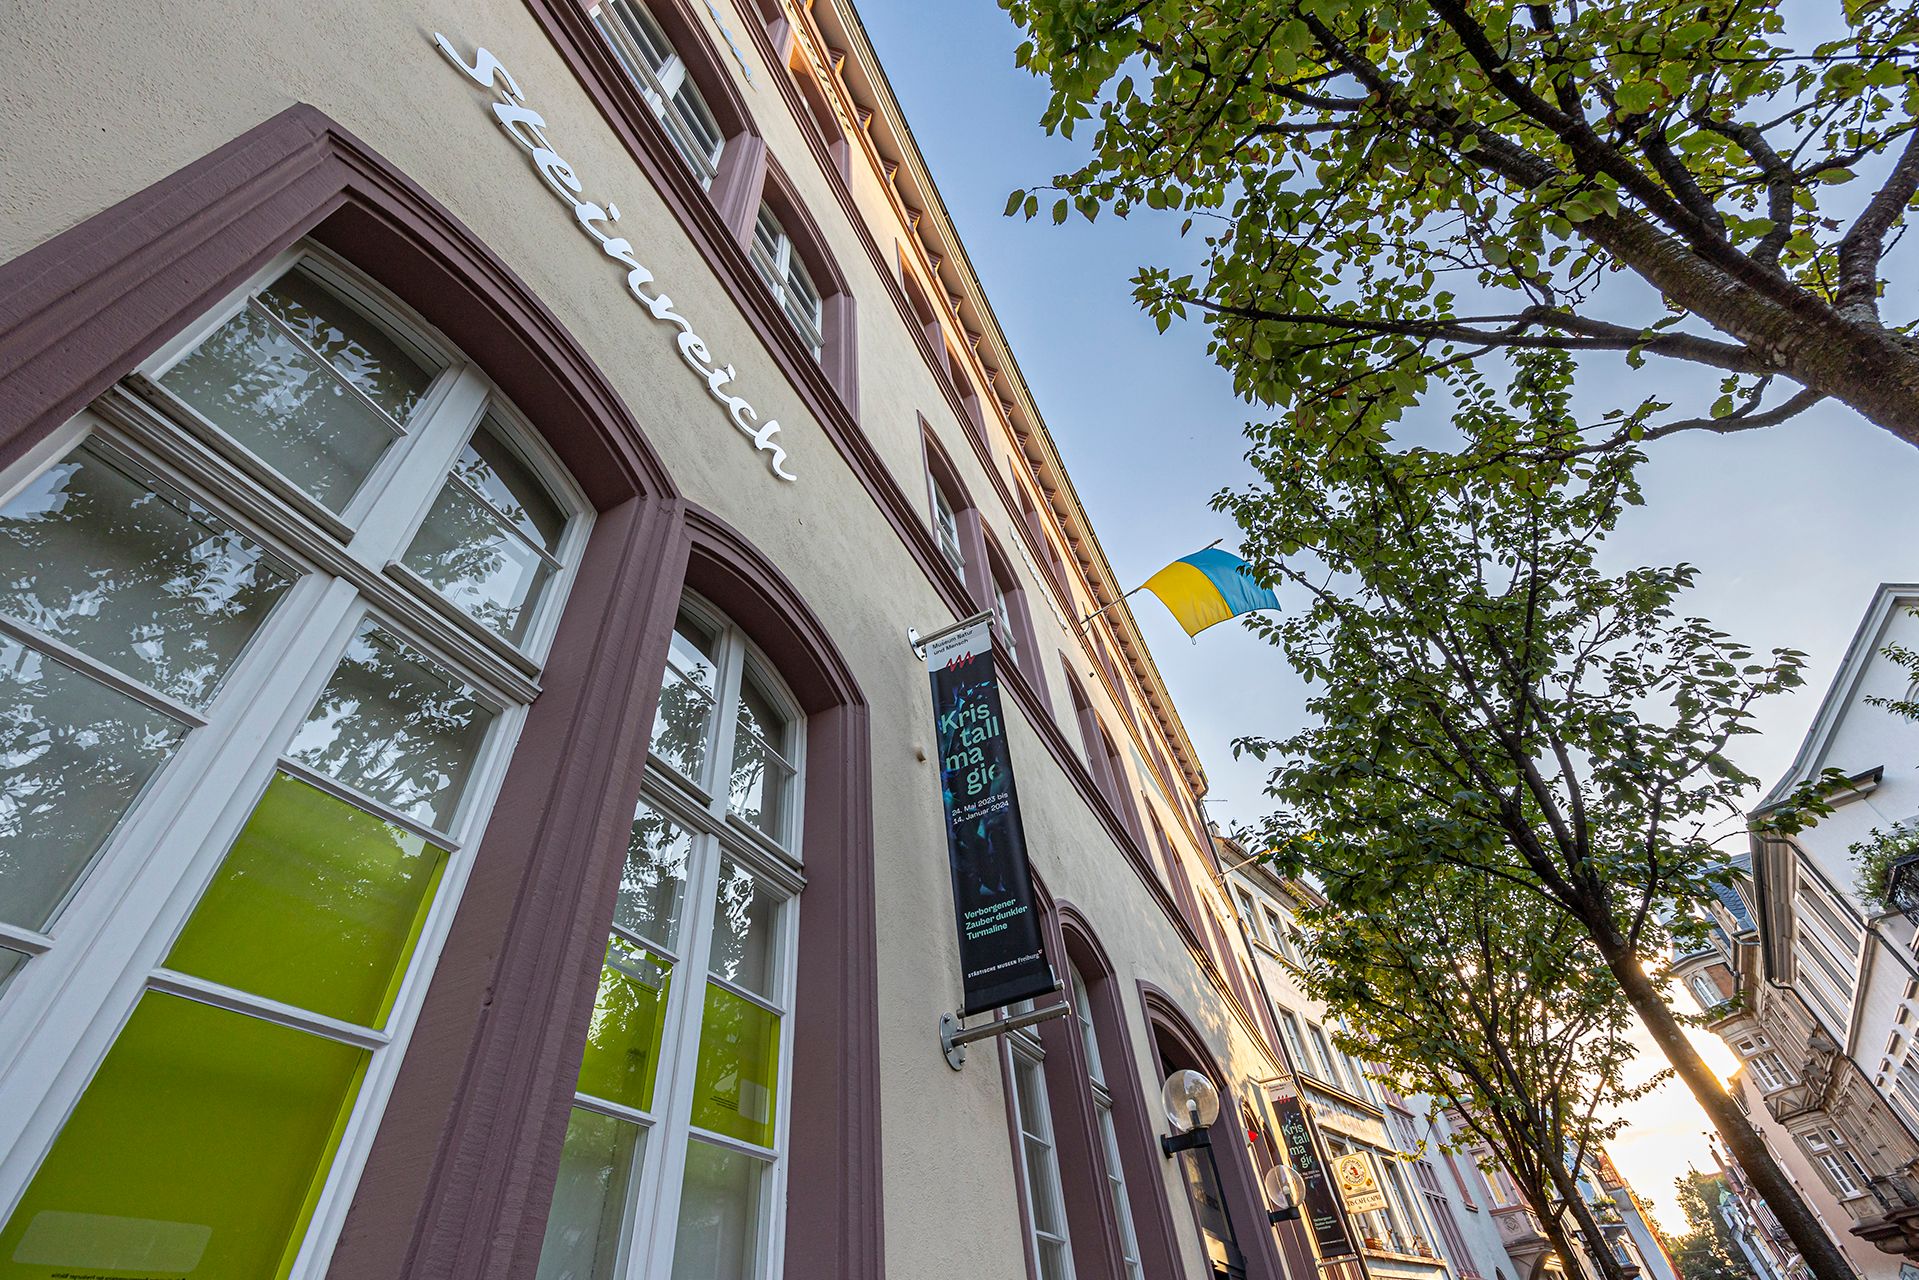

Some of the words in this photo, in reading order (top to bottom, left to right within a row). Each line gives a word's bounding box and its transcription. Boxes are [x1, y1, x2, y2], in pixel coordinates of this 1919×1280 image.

[434, 31, 798, 482] Steinreich
[941, 703, 990, 735] Kris
[960, 716, 999, 747] tall
[945, 746, 984, 772] ma
[964, 802, 977, 812] Mai
[977, 796, 996, 807] 2023
[997, 792, 1009, 800] bis
[965, 808, 990, 820] Januar
[990, 800, 1009, 811] 2024
[964, 898, 1016, 920] Verborgener
[965, 916, 995, 930] Zauber
[995, 905, 1028, 921] dunkler
[966, 922, 1008, 940] Turmaline
[1017, 953, 1040, 964] Freiburg
[1281, 1123, 1304, 1136] Kris
[1292, 1132, 1310, 1145] tall
[1290, 1145, 1306, 1156] ma
